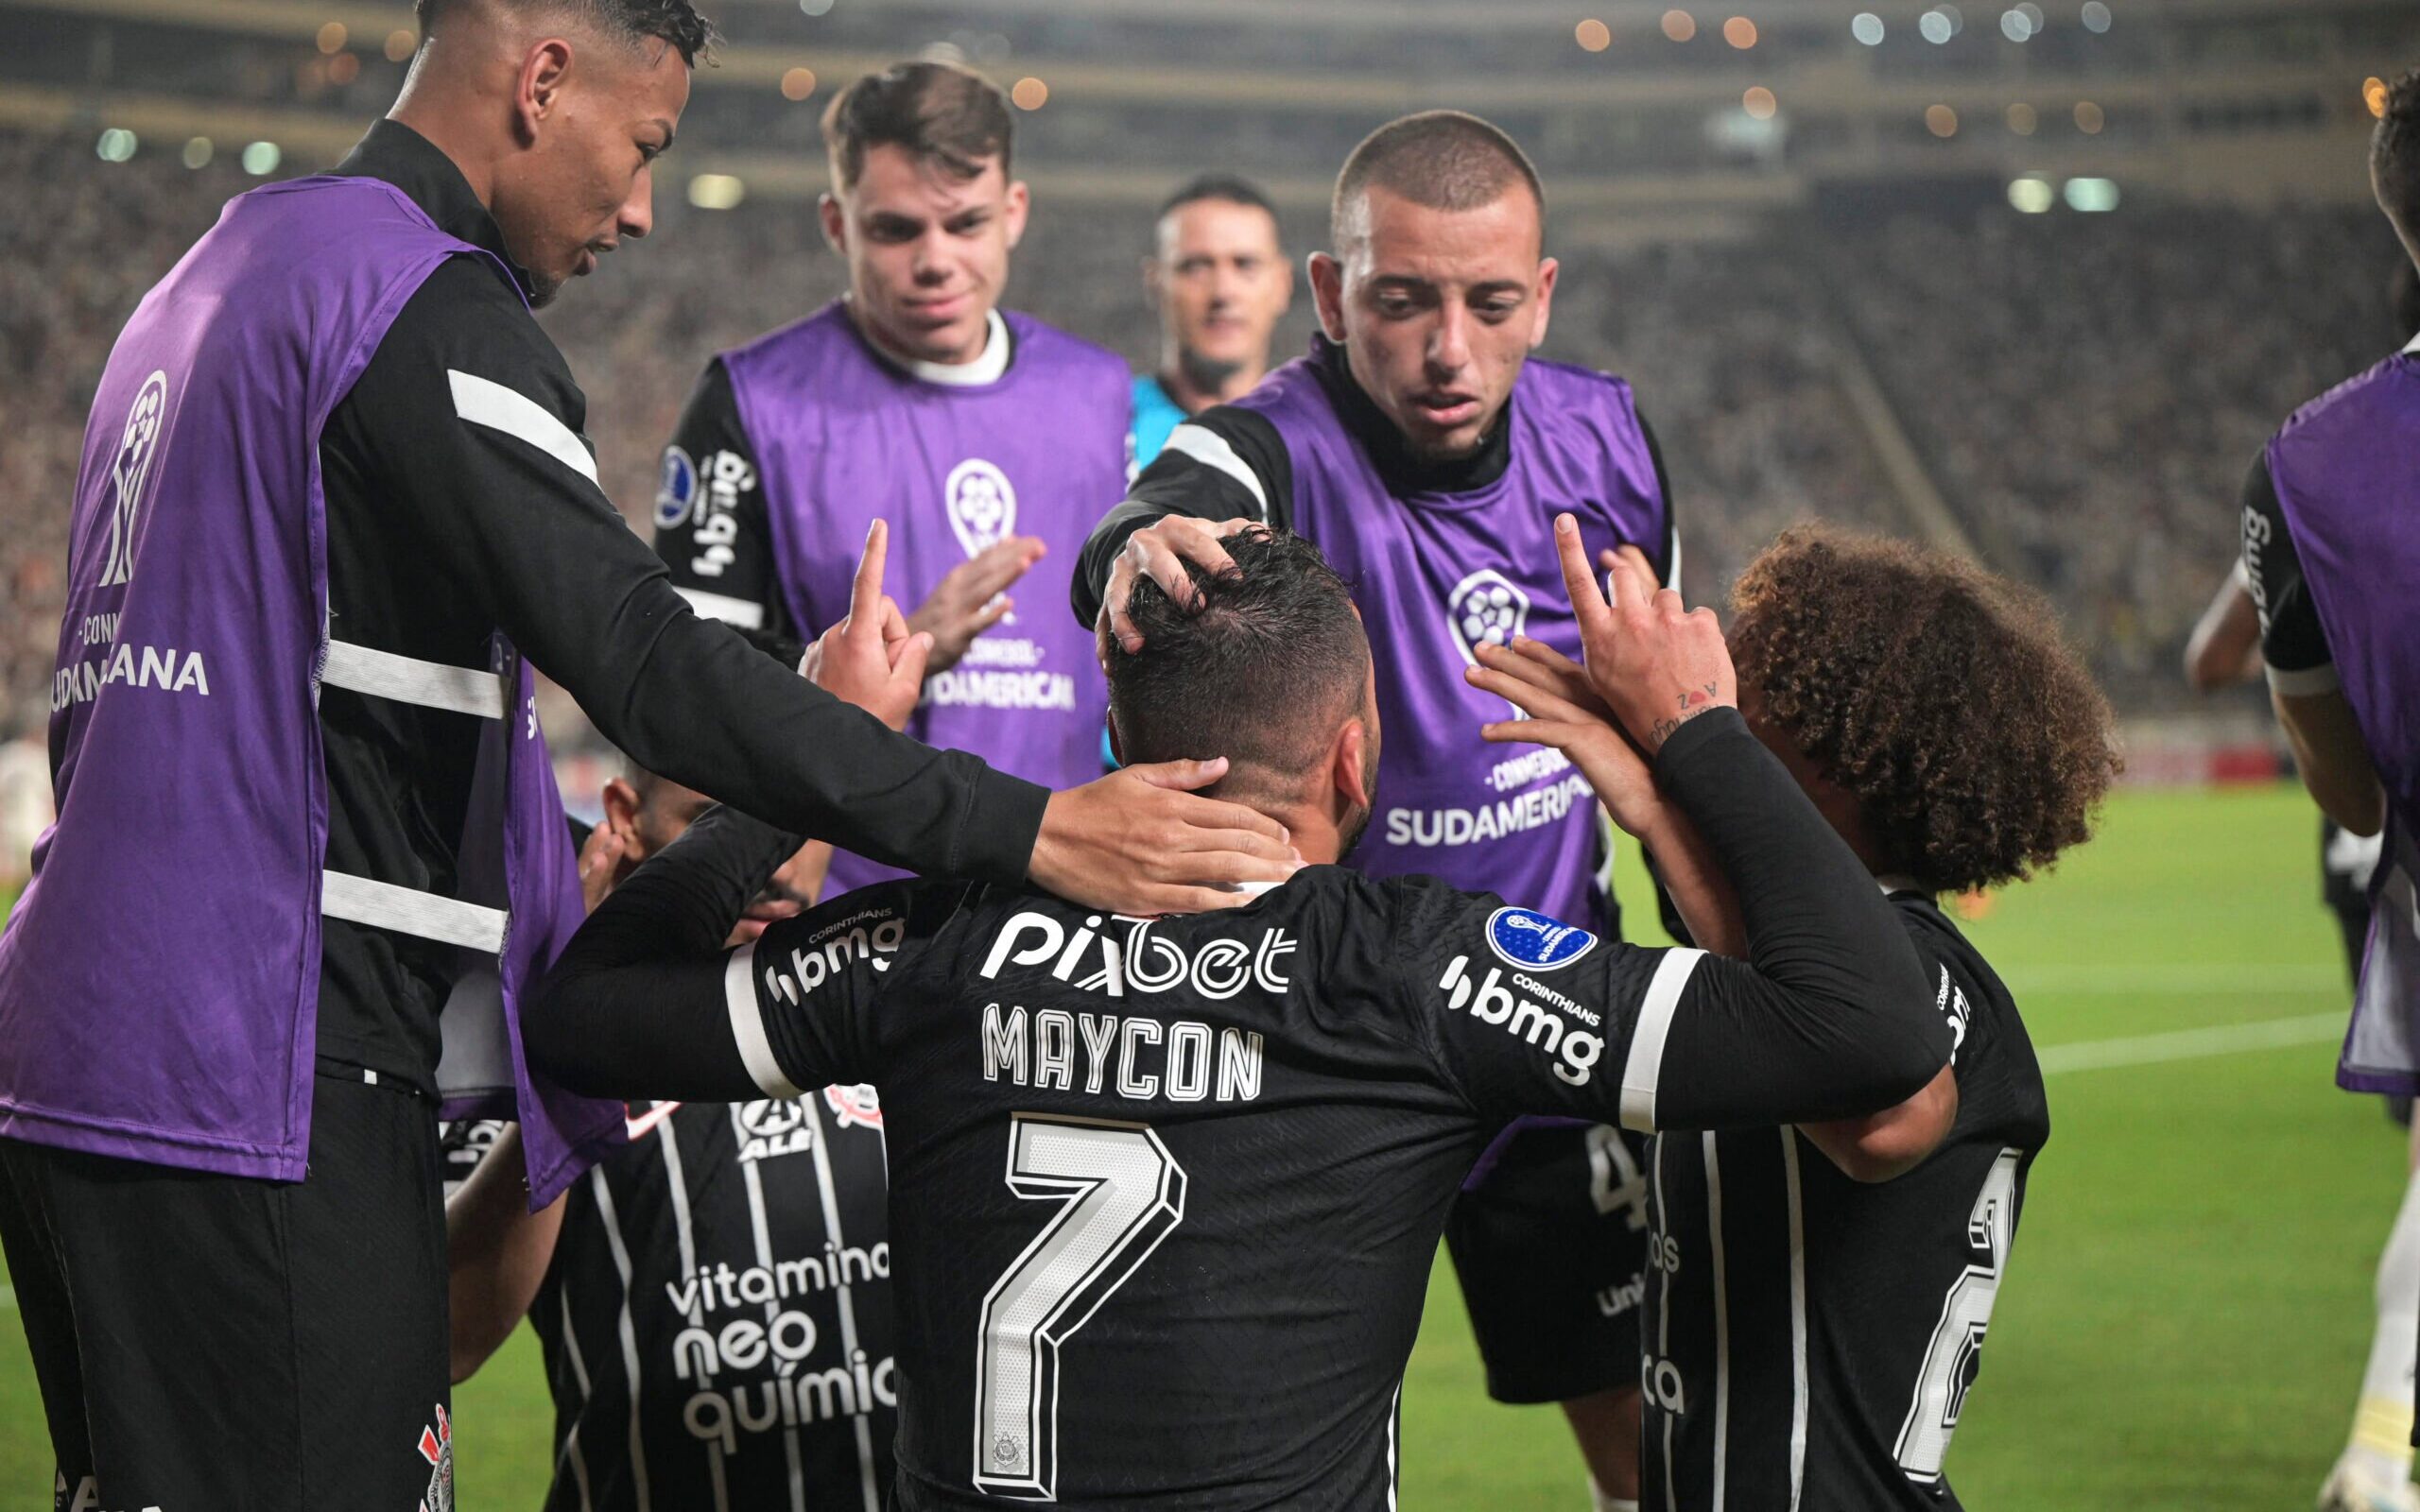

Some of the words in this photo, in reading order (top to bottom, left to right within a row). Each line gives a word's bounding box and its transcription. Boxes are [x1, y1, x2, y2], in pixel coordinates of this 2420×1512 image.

[791, 917, 906, 993] bmg
[808, 907, 892, 944] CORINTHIANS
[1470, 968, 1605, 1086] bmg
[1512, 972, 1601, 1026] CORINTHIANS
[981, 1003, 1263, 1101] MAYCON
[1586, 1125, 1648, 1231] 4
[672, 1311, 817, 1380] neo
[973, 1111, 1187, 1502] 7
